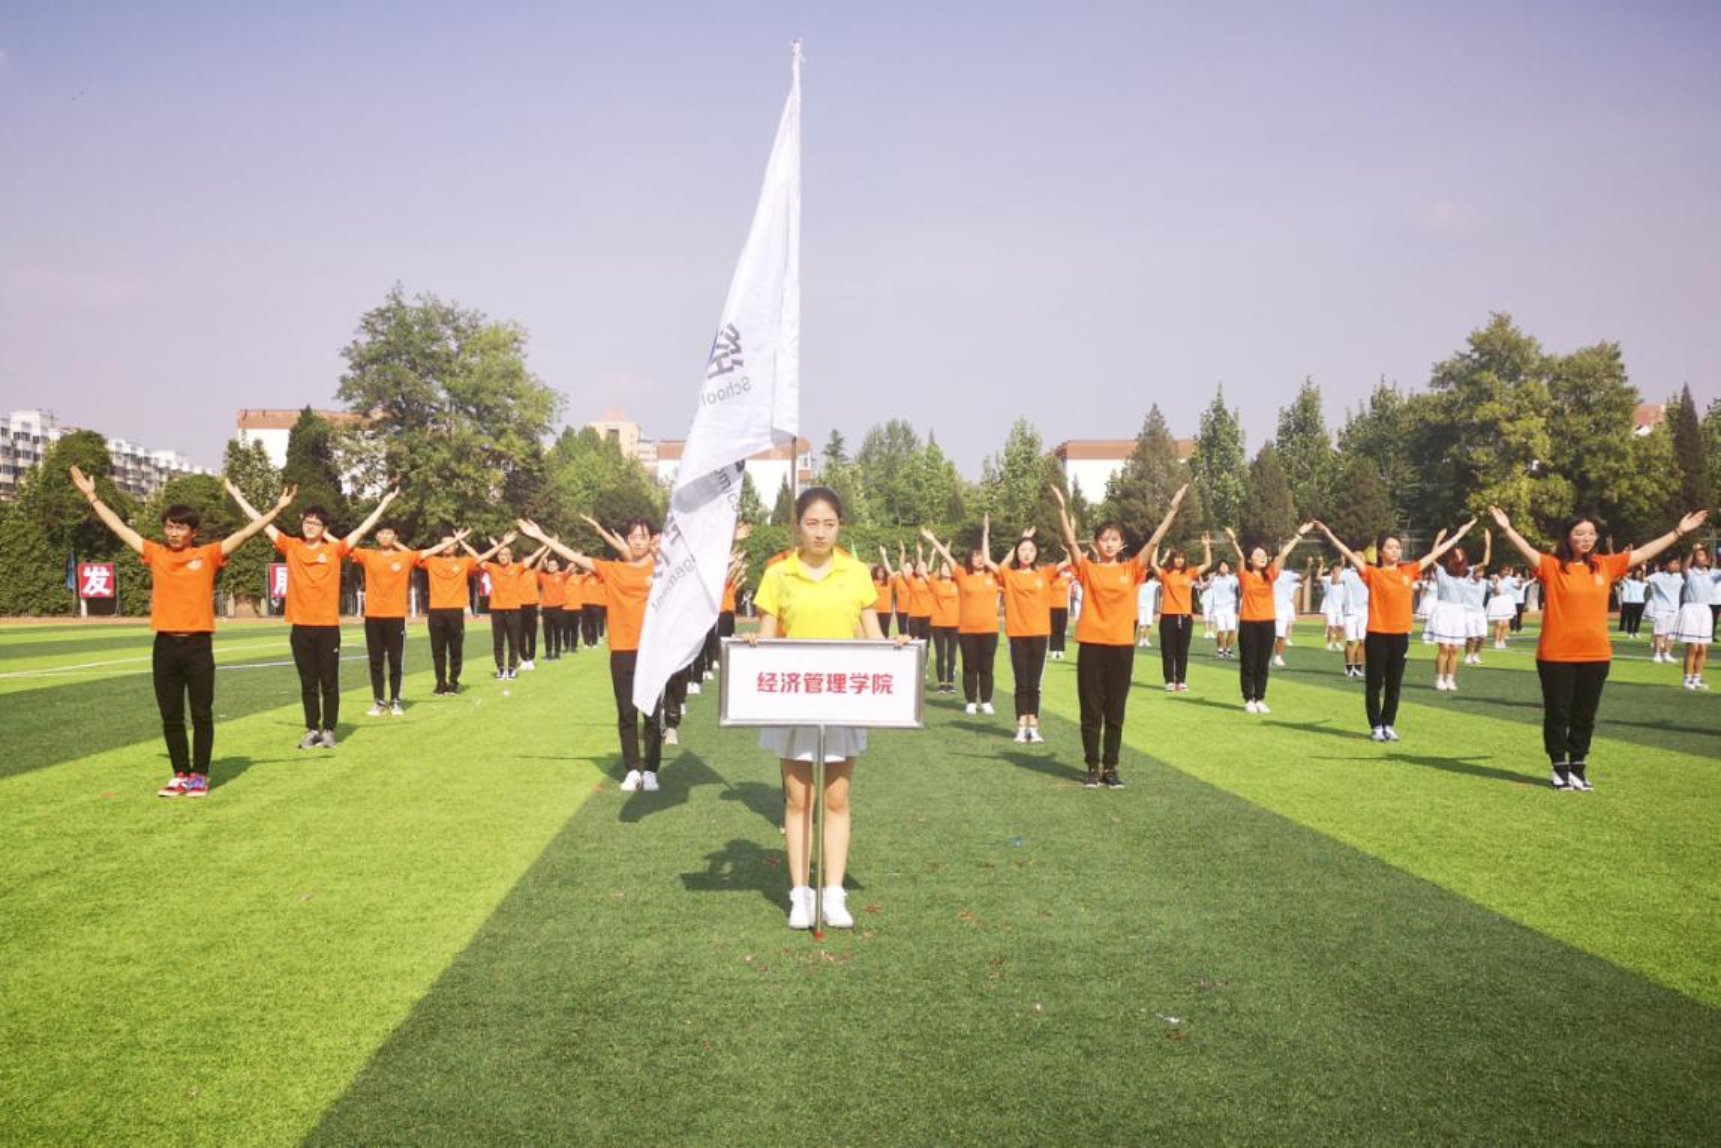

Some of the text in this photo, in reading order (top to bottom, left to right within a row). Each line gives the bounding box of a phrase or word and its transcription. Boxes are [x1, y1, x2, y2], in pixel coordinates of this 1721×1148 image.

[82, 565, 111, 596] 发
[757, 672, 894, 694] 经济管理学院
